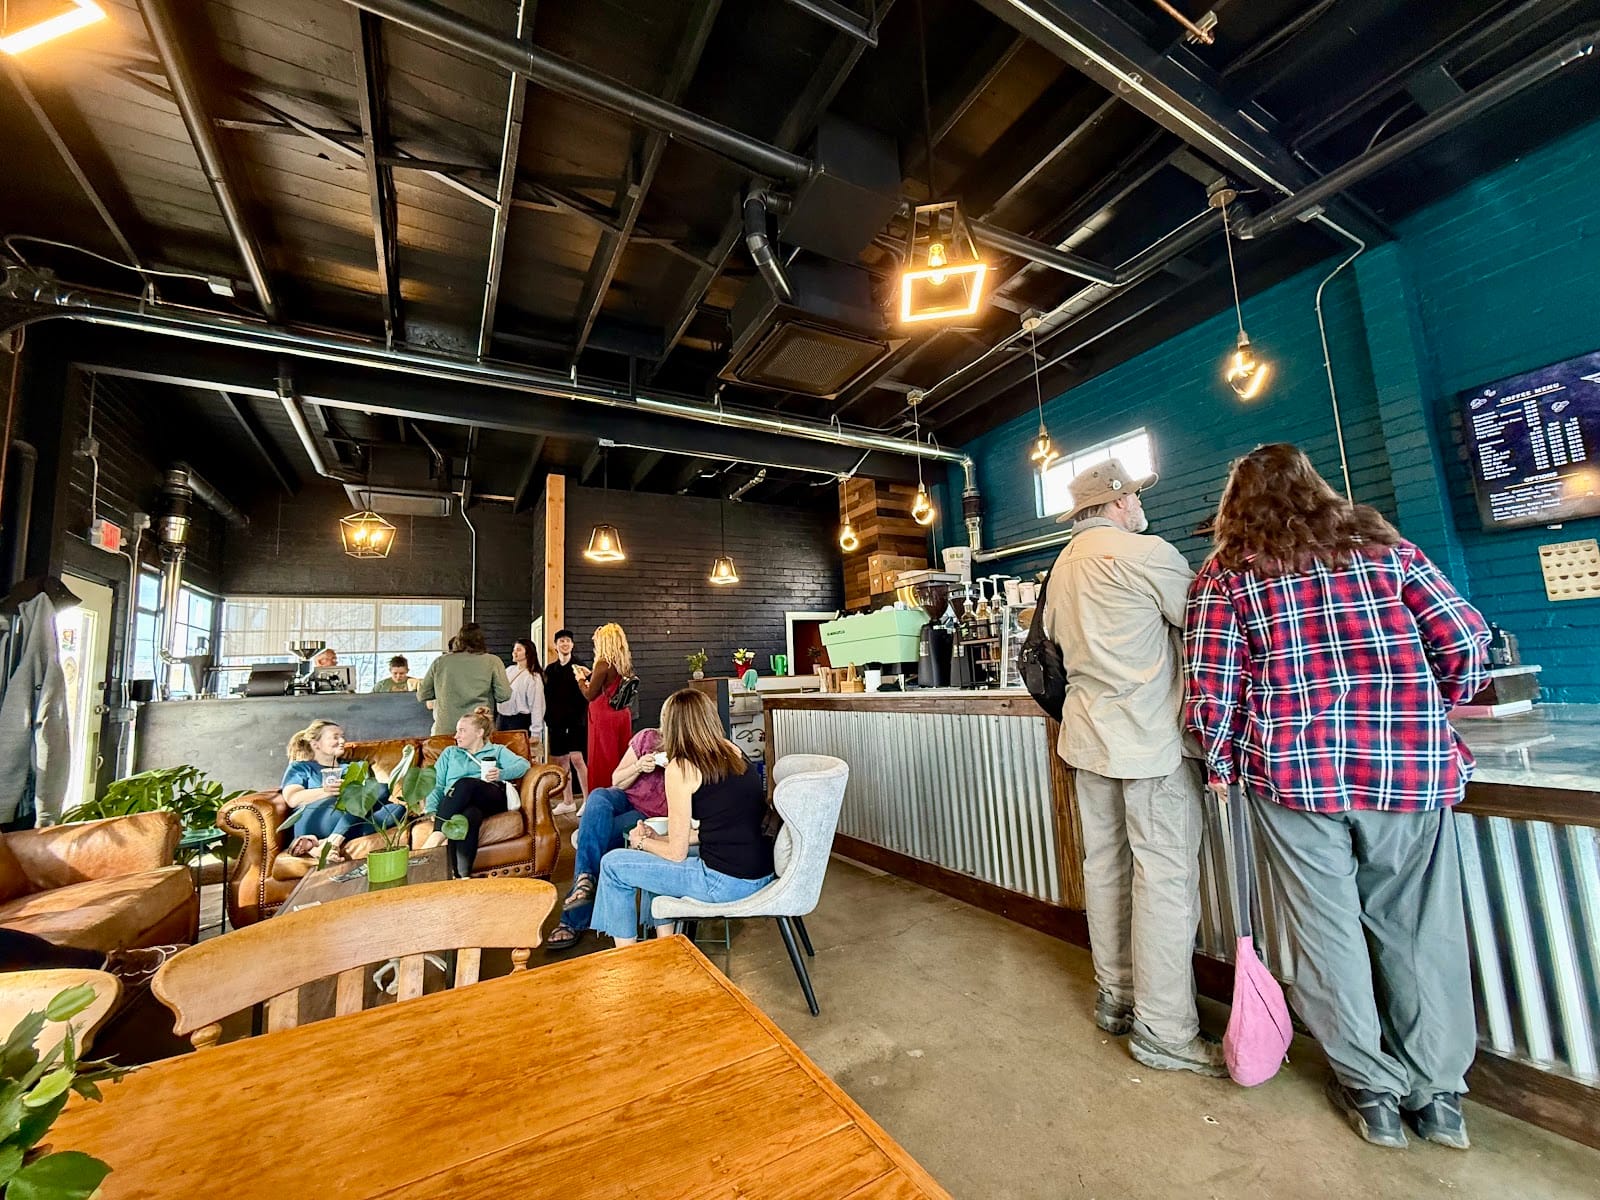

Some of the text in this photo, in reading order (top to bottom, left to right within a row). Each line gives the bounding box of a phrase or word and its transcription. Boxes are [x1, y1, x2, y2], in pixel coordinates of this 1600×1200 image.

[1500, 382, 1560, 403] COFFEE MENU
[1523, 471, 1558, 483] OPTIONS
